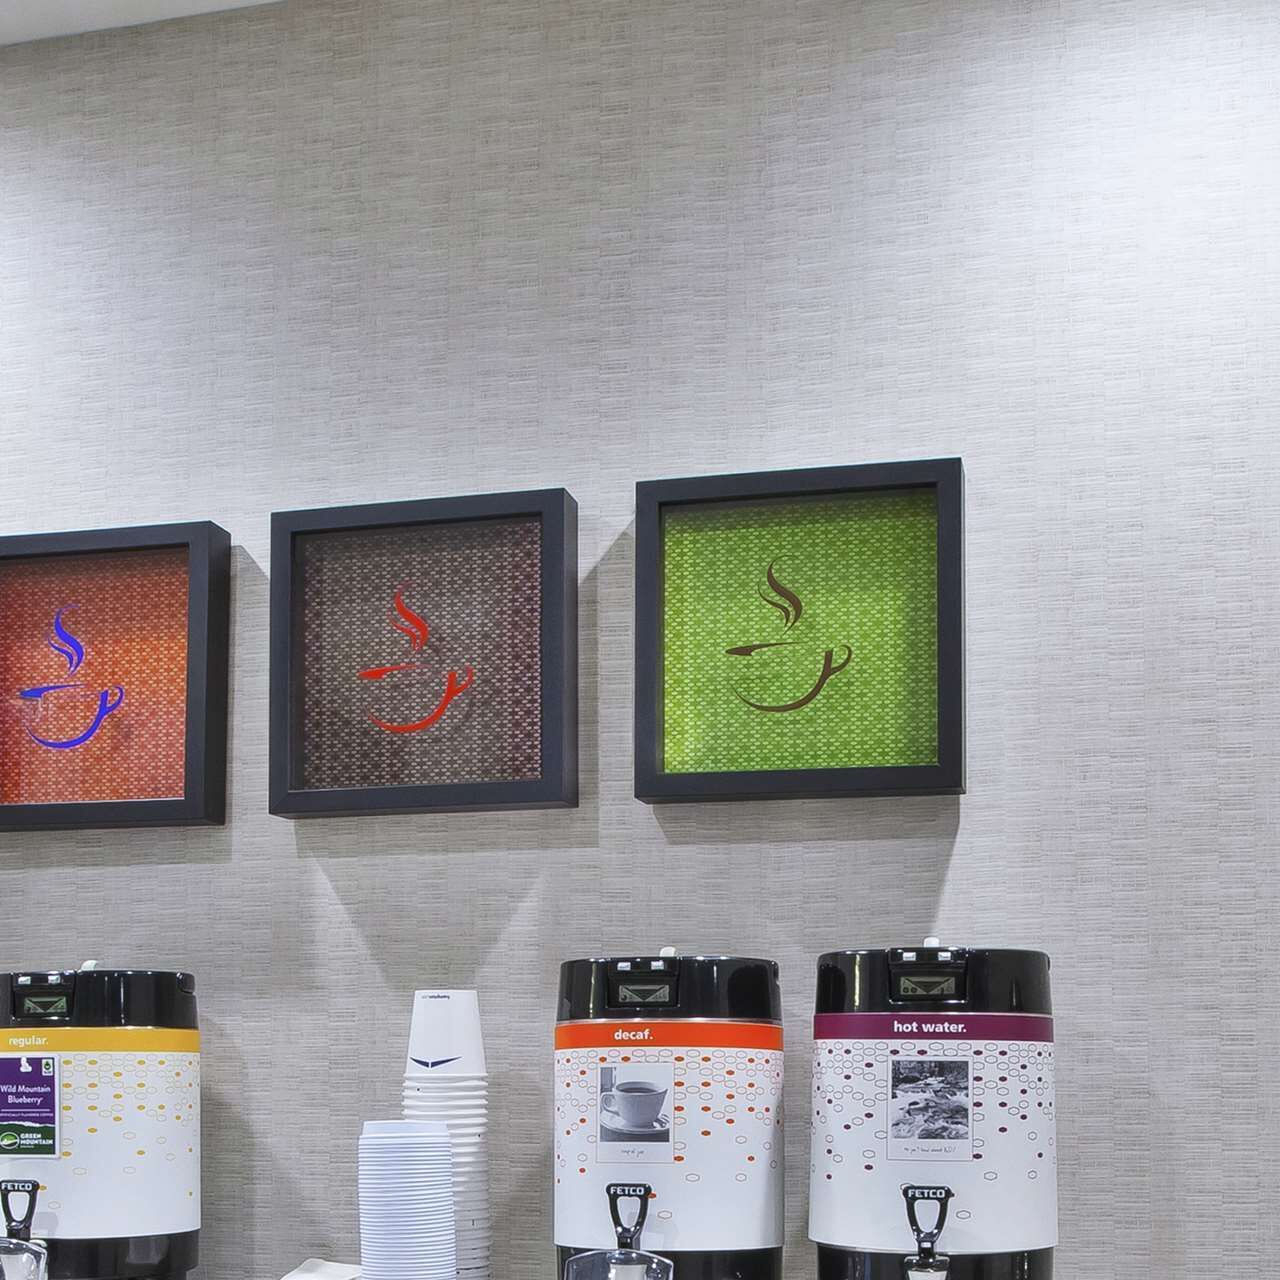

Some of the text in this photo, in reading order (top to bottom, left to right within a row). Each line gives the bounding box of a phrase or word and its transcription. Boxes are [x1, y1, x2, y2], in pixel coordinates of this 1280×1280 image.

[893, 1020, 967, 1033] hot water.
[614, 1028, 654, 1041] decaf.
[8, 1035, 49, 1048] regular.
[0, 1084, 51, 1093] Wild Mountain
[7, 1095, 44, 1106] Blueberry
[1, 1182, 33, 1191] FETCO
[610, 1186, 645, 1195] FETCO
[908, 1189, 946, 1198] FETCO
